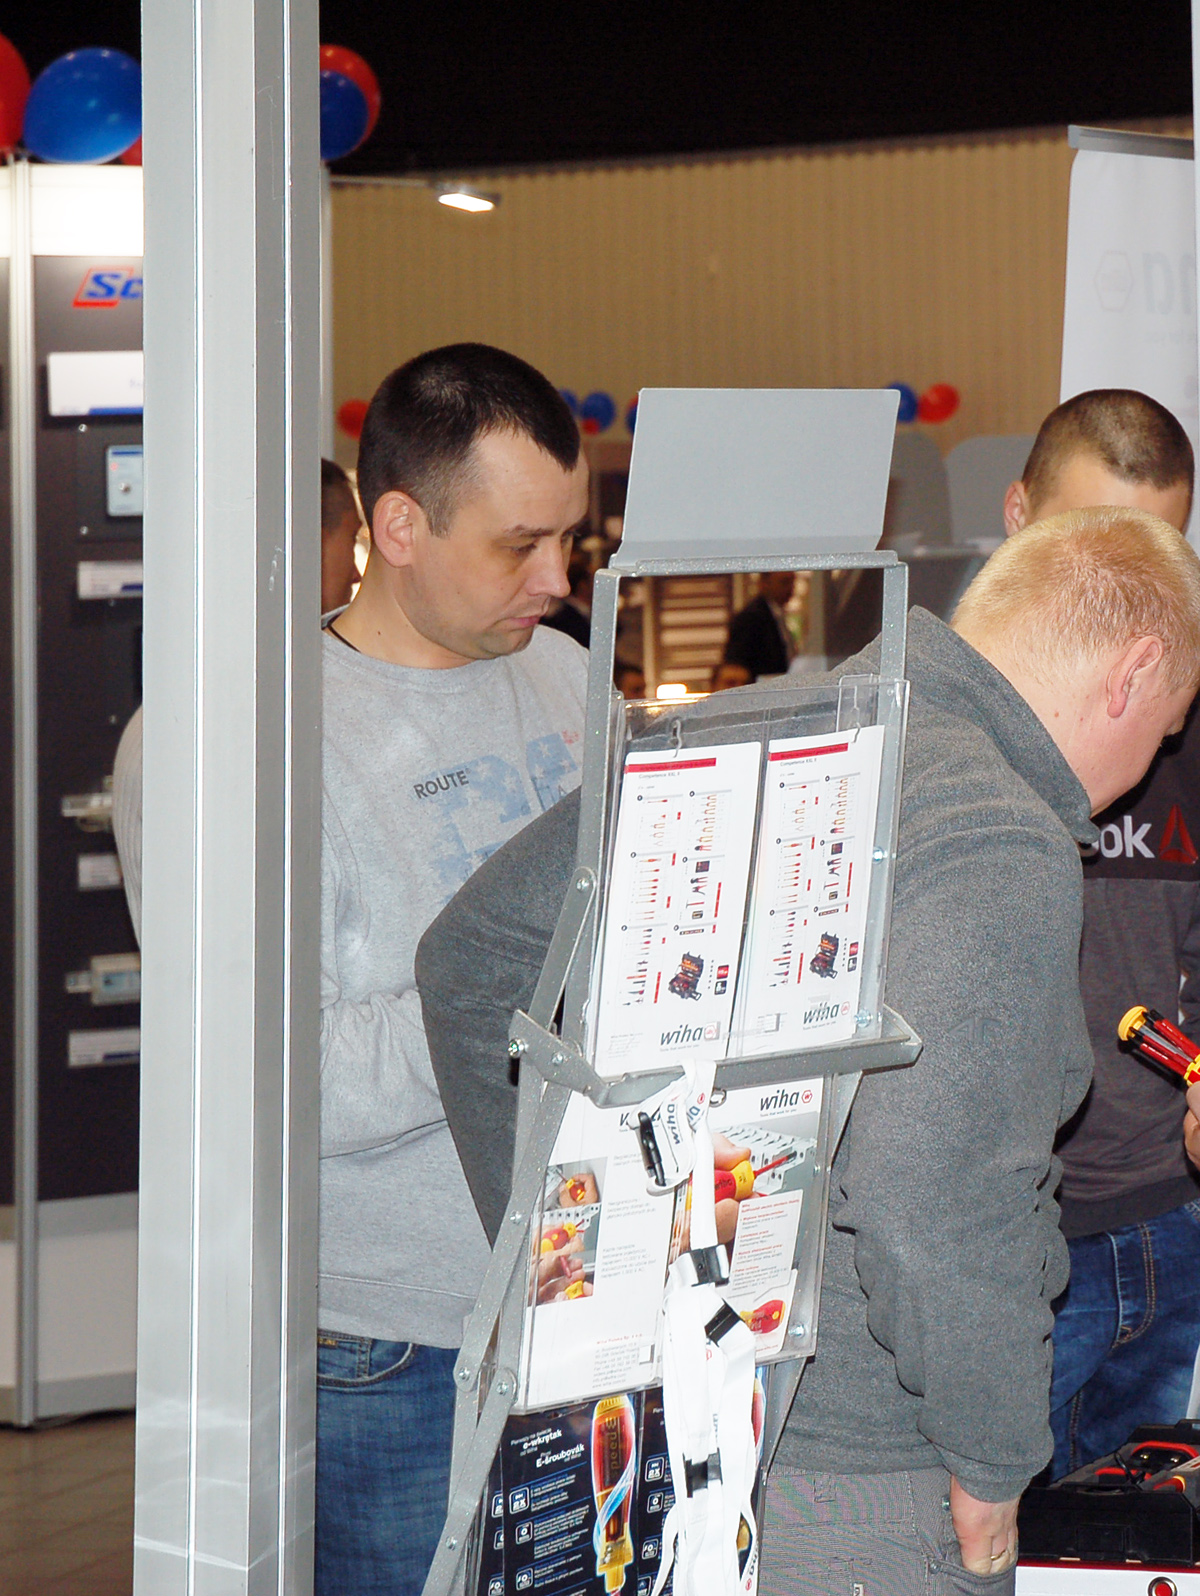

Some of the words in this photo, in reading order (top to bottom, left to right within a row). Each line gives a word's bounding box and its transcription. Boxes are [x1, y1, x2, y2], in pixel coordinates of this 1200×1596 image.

[413, 770, 470, 799] ROUTE
[1092, 815, 1155, 858] ok
[803, 1002, 841, 1025] wiha
[660, 1024, 704, 1046] wiha
[760, 1089, 800, 1111] wiha
[666, 1104, 680, 1145] wiha
